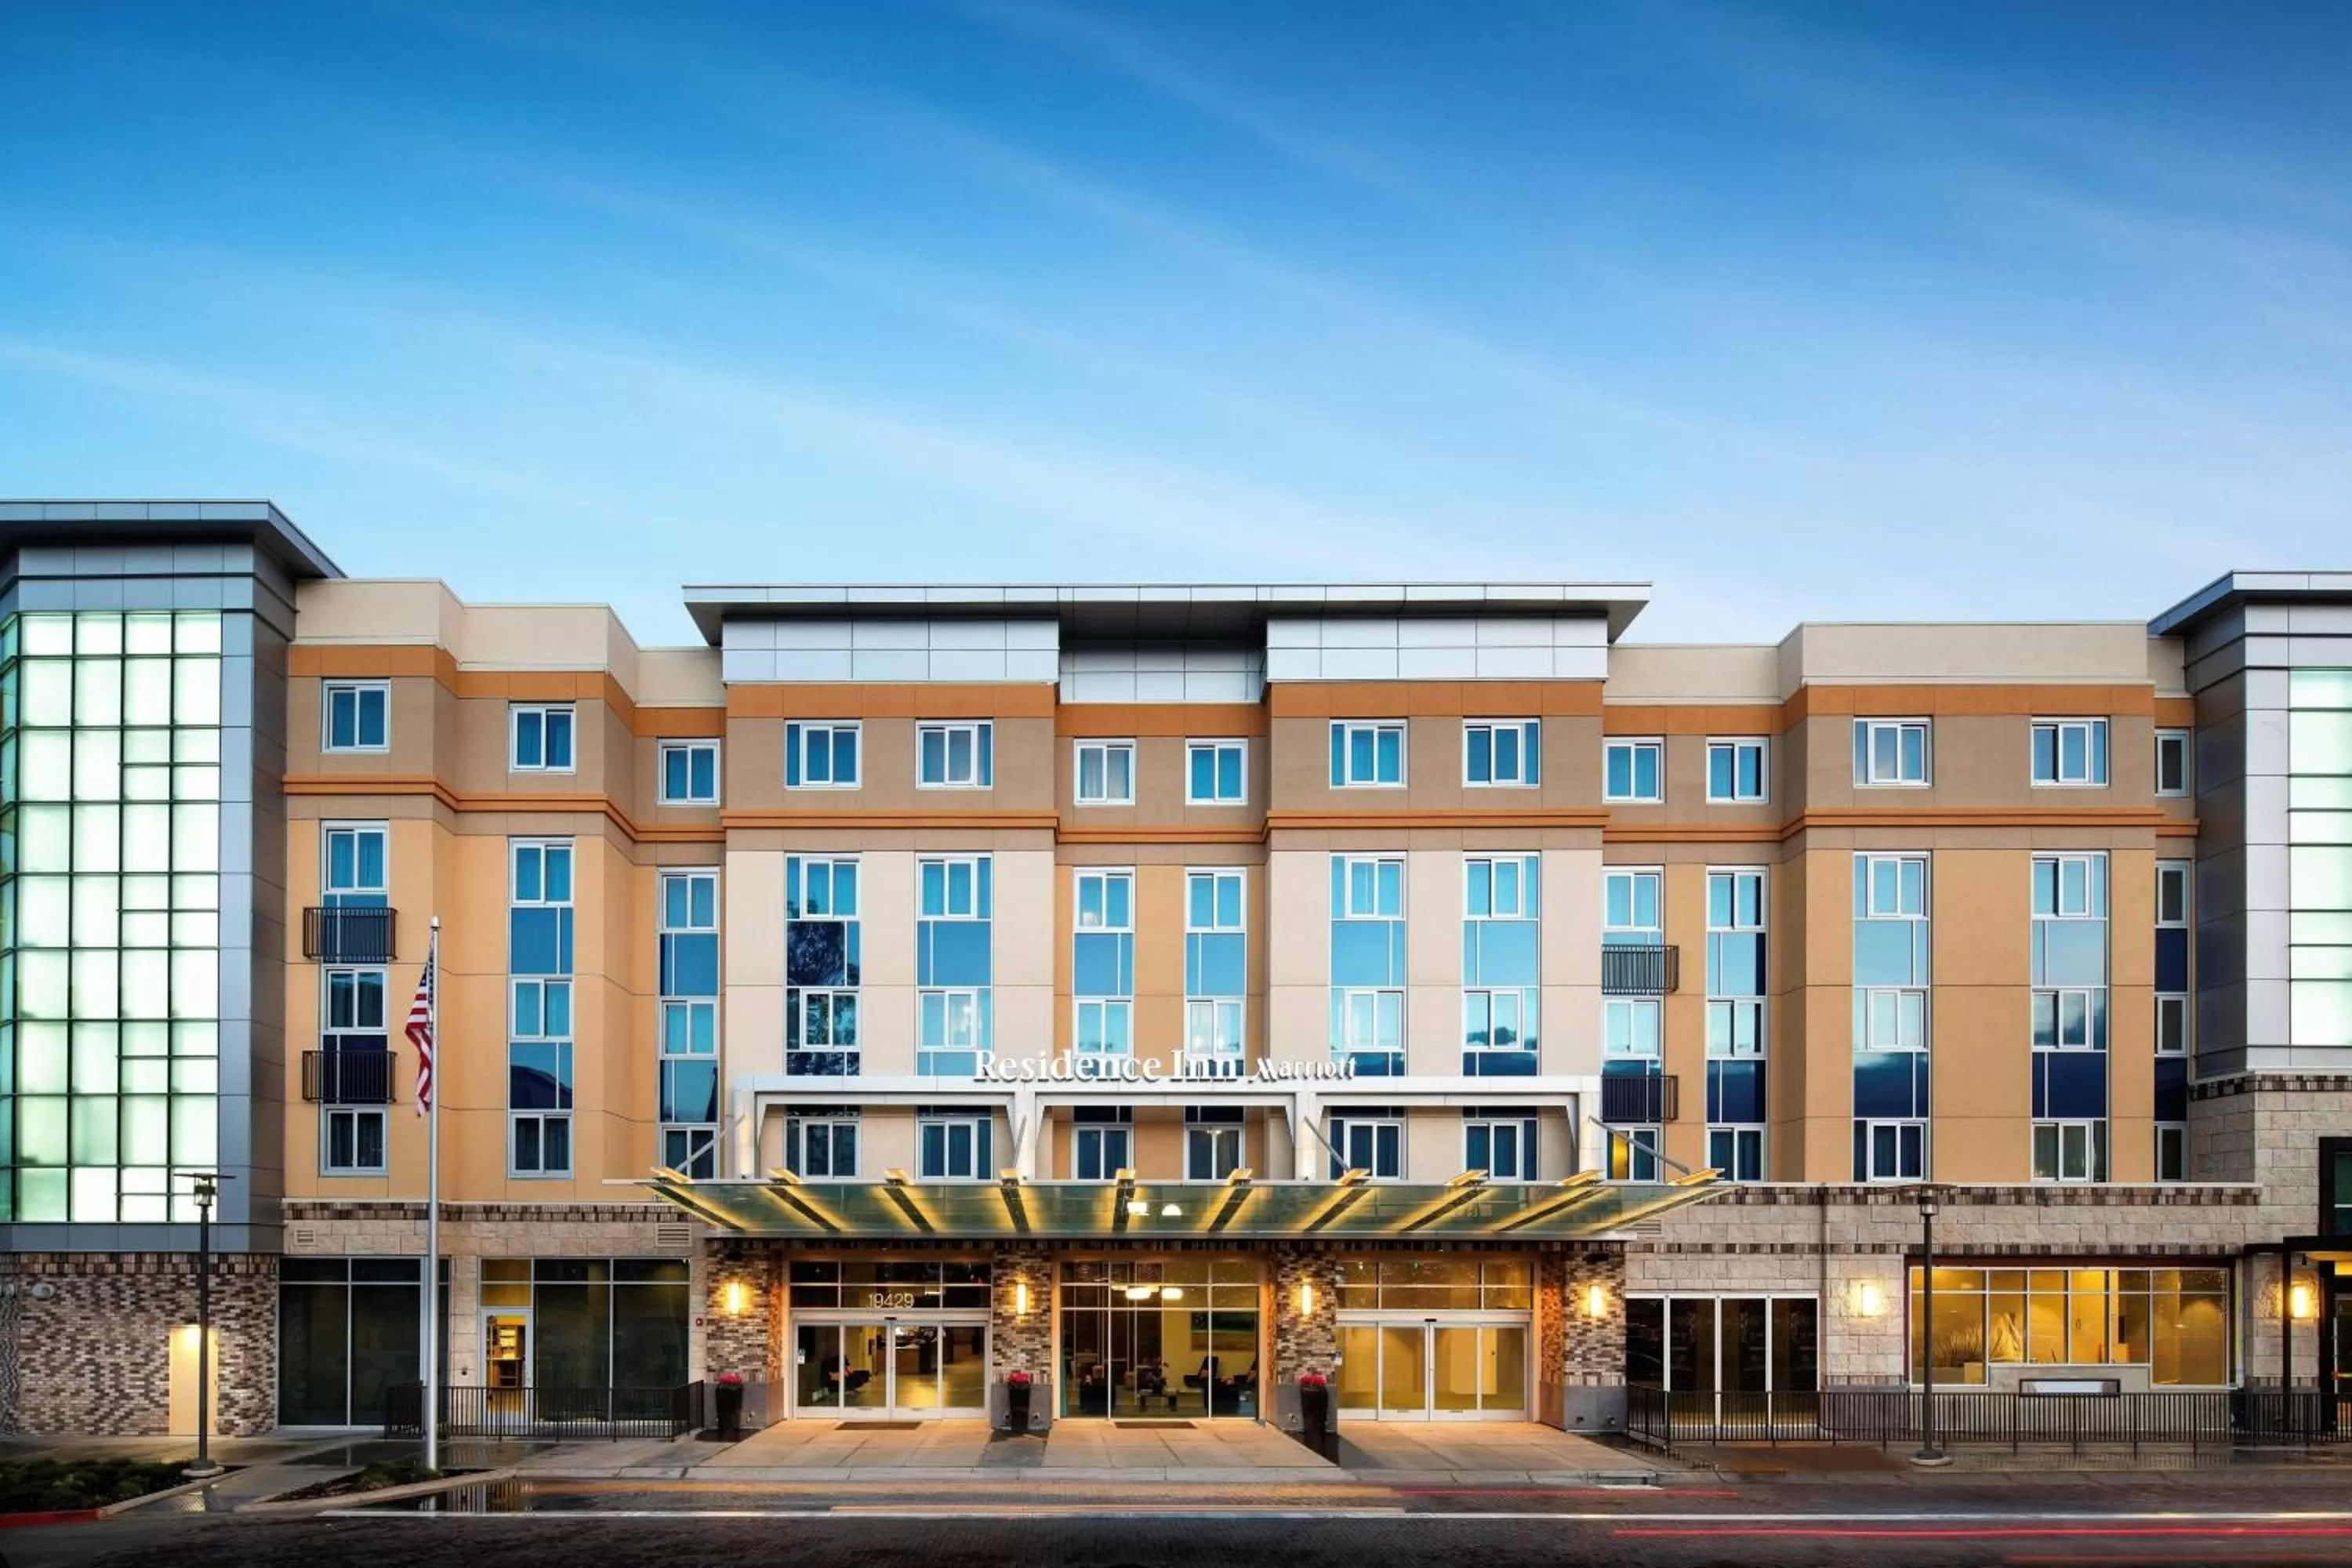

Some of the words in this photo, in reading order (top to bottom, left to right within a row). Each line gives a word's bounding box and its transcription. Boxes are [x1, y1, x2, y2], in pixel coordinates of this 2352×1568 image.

[973, 1049, 1162, 1081] Residence
[1170, 1050, 1238, 1081] Inn
[1248, 1057, 1356, 1083] Marriott
